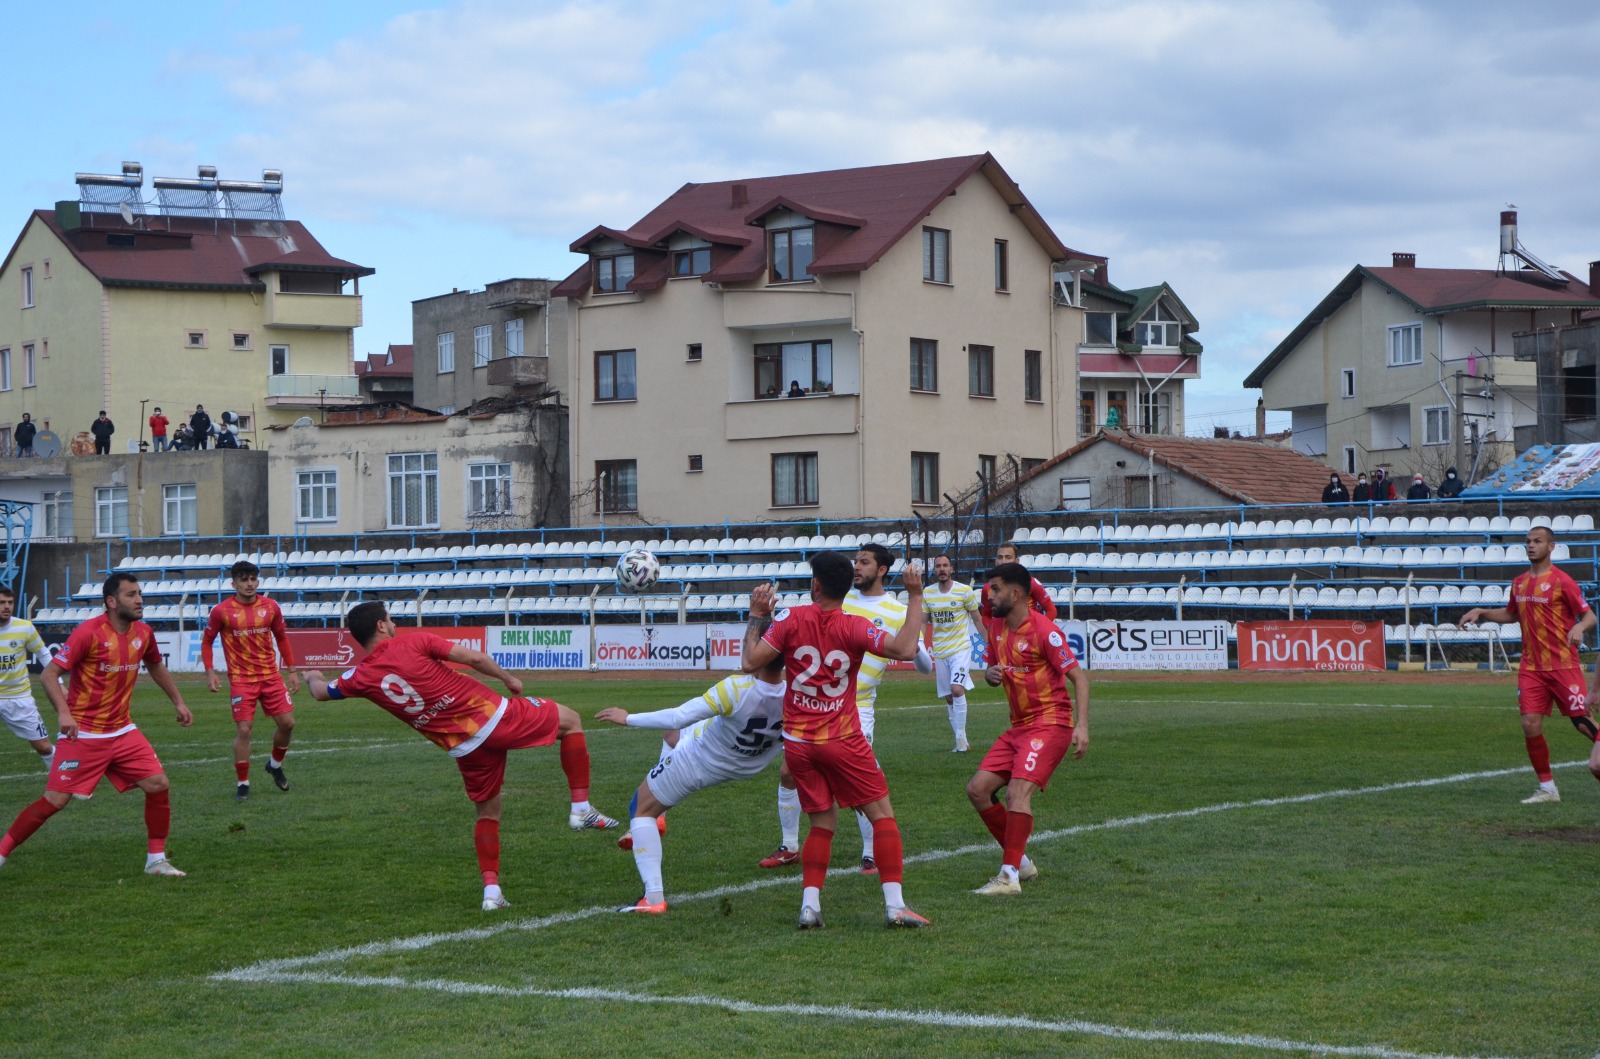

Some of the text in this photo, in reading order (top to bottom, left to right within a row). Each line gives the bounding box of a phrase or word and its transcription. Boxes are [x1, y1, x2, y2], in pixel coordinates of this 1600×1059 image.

[501, 628, 573, 648] EMEK İNŞAAT
[1092, 623, 1224, 652] ets enerji
[1251, 629, 1371, 662] hünkar
[492, 650, 583, 668] TARIM ÜRÜNLERİ
[1315, 660, 1365, 671] restoran
[792, 645, 850, 697] 23
[953, 672, 966, 684] 27
[381, 673, 425, 714] 9
[792, 693, 845, 713] F.KONAK
[1569, 694, 1585, 711] 29
[1024, 751, 1038, 772] 5
